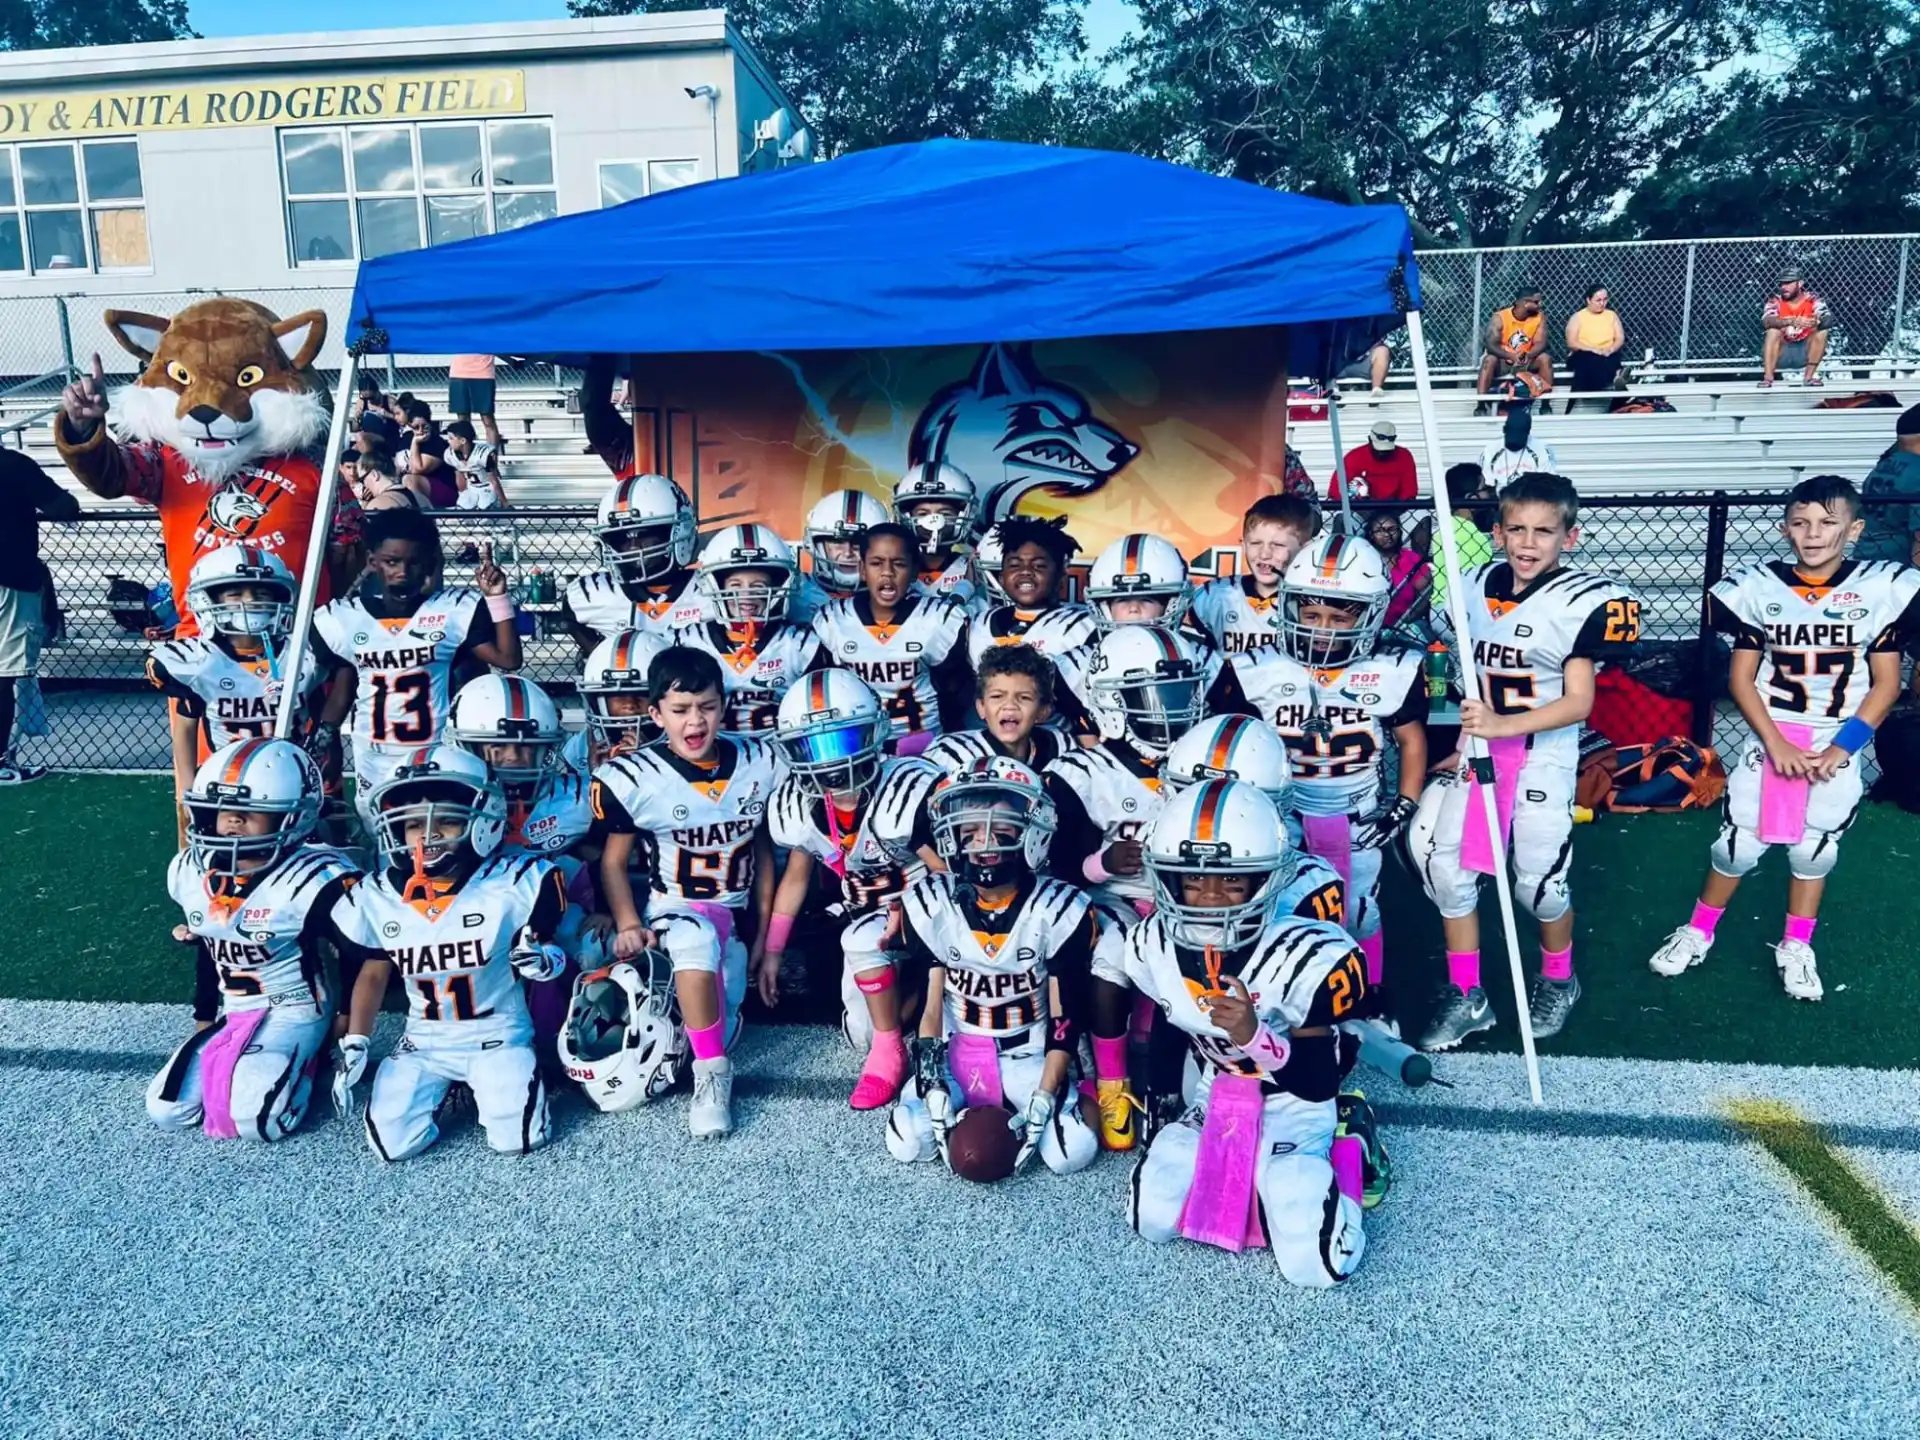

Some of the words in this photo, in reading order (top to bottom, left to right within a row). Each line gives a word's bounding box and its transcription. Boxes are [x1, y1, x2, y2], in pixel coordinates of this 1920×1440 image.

[48, 100, 72, 131] &
[80, 93, 192, 129] ANITA
[202, 83, 386, 124] RODGERS
[395, 78, 514, 113] FIELD
[1604, 600, 1641, 642] 25
[1764, 624, 1861, 646] CHAPEL
[1349, 673, 1381, 684] POP
[1769, 651, 1855, 718] 57
[371, 672, 433, 743] 13
[675, 845, 757, 899] 60
[415, 974, 477, 1021] 11
[945, 966, 1045, 999] CHAPEL
[1327, 951, 1365, 1017] 27
